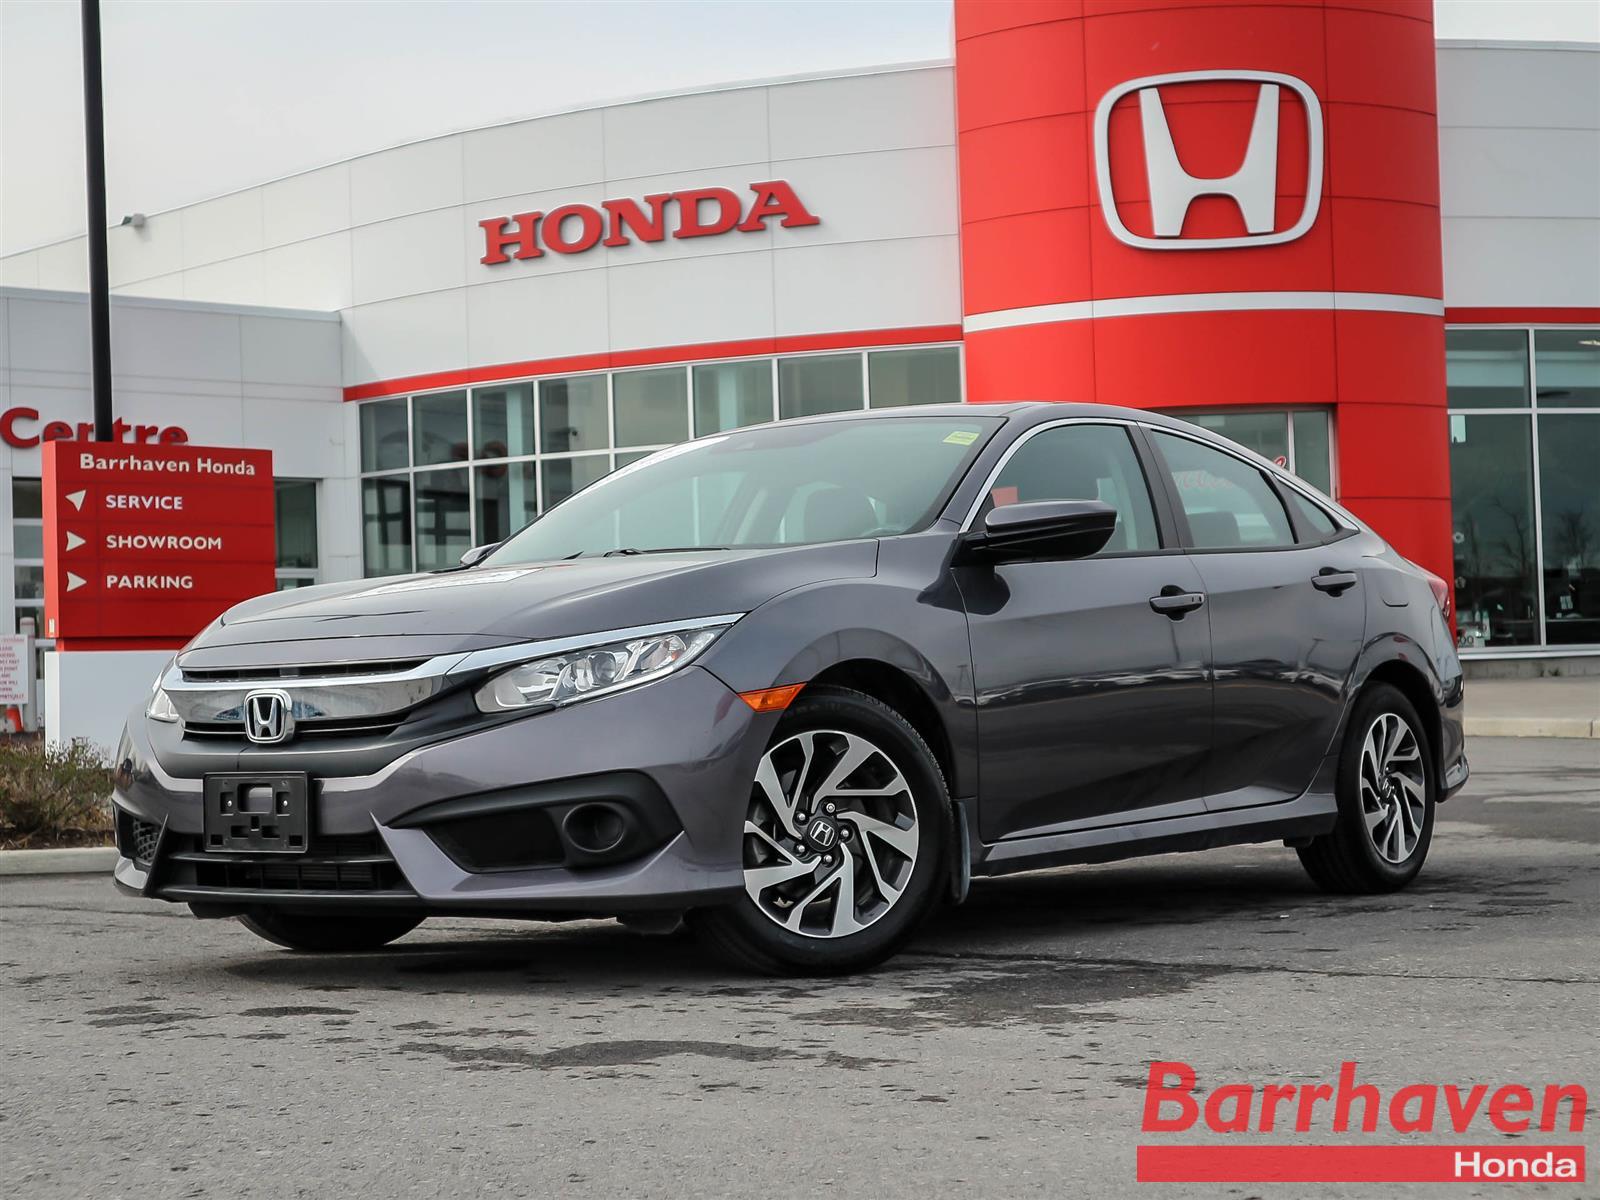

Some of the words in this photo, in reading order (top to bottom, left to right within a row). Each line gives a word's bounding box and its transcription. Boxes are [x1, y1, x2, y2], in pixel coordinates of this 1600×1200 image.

[479, 179, 820, 265] HONDA
[79, 453, 190, 473] Barrhaven
[197, 457, 256, 476] Honda
[105, 494, 183, 511] SERVICE
[105, 534, 223, 551] SHOWROOM
[105, 575, 193, 590] PARKING
